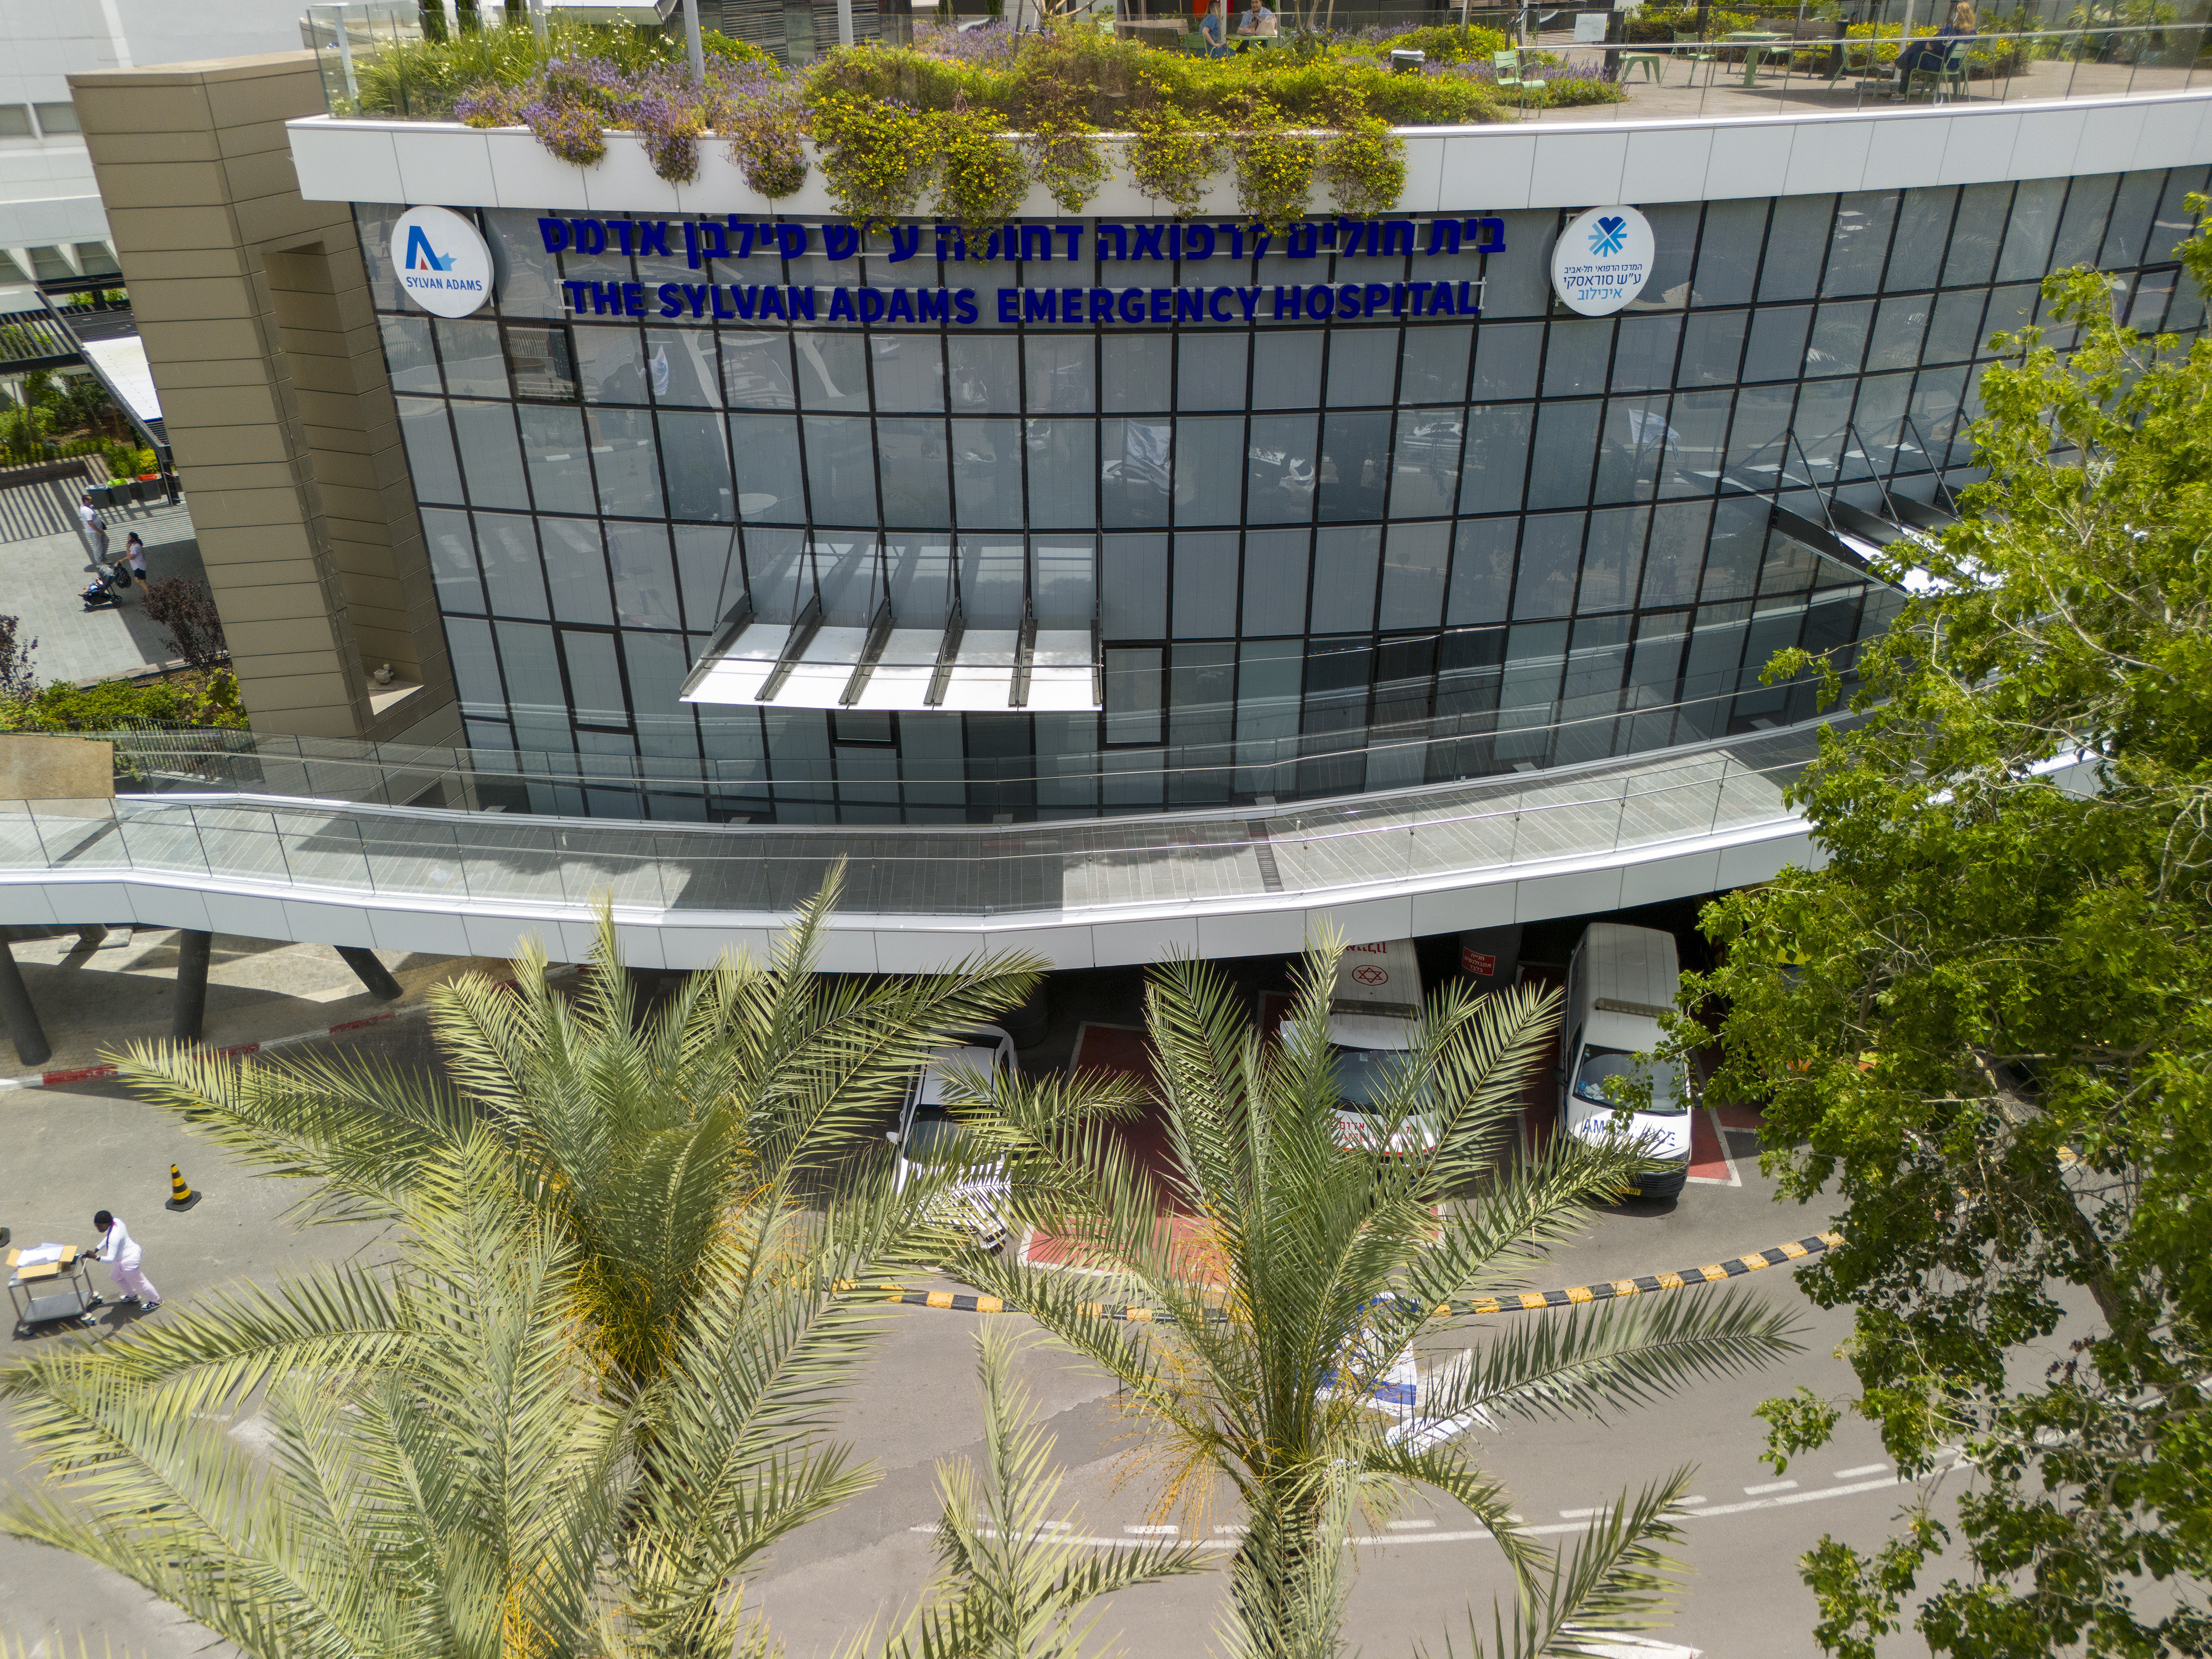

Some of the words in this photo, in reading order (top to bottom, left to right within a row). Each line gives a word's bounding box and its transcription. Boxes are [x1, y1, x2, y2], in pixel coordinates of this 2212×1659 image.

[538, 217, 673, 257] אדמס
[683, 214, 807, 269] סילבן
[936, 225, 1083, 261] דחופה
[1098, 215, 1272, 260] לרפואה
[1287, 216, 1415, 258] חולים
[1426, 217, 1506, 256] בית
[1564, 265, 1593, 274] תל-אביב
[406, 276, 443, 289] SYLVAN
[446, 279, 482, 291] ADAMS
[1563, 275, 1614, 290] סוראסקי
[1577, 288, 1623, 300] איכילוב
[564, 280, 649, 317] THE
[658, 283, 816, 321] SYLVAN
[828, 287, 979, 325] ADAMS
[998, 286, 1263, 324] EMERGENCY
[1274, 281, 1479, 321] HOSPITAL
[1464, 956, 1491, 968] אמבולנסים
[1469, 964, 1483, 973] בלבד
[1470, 953, 1485, 961] חניית
